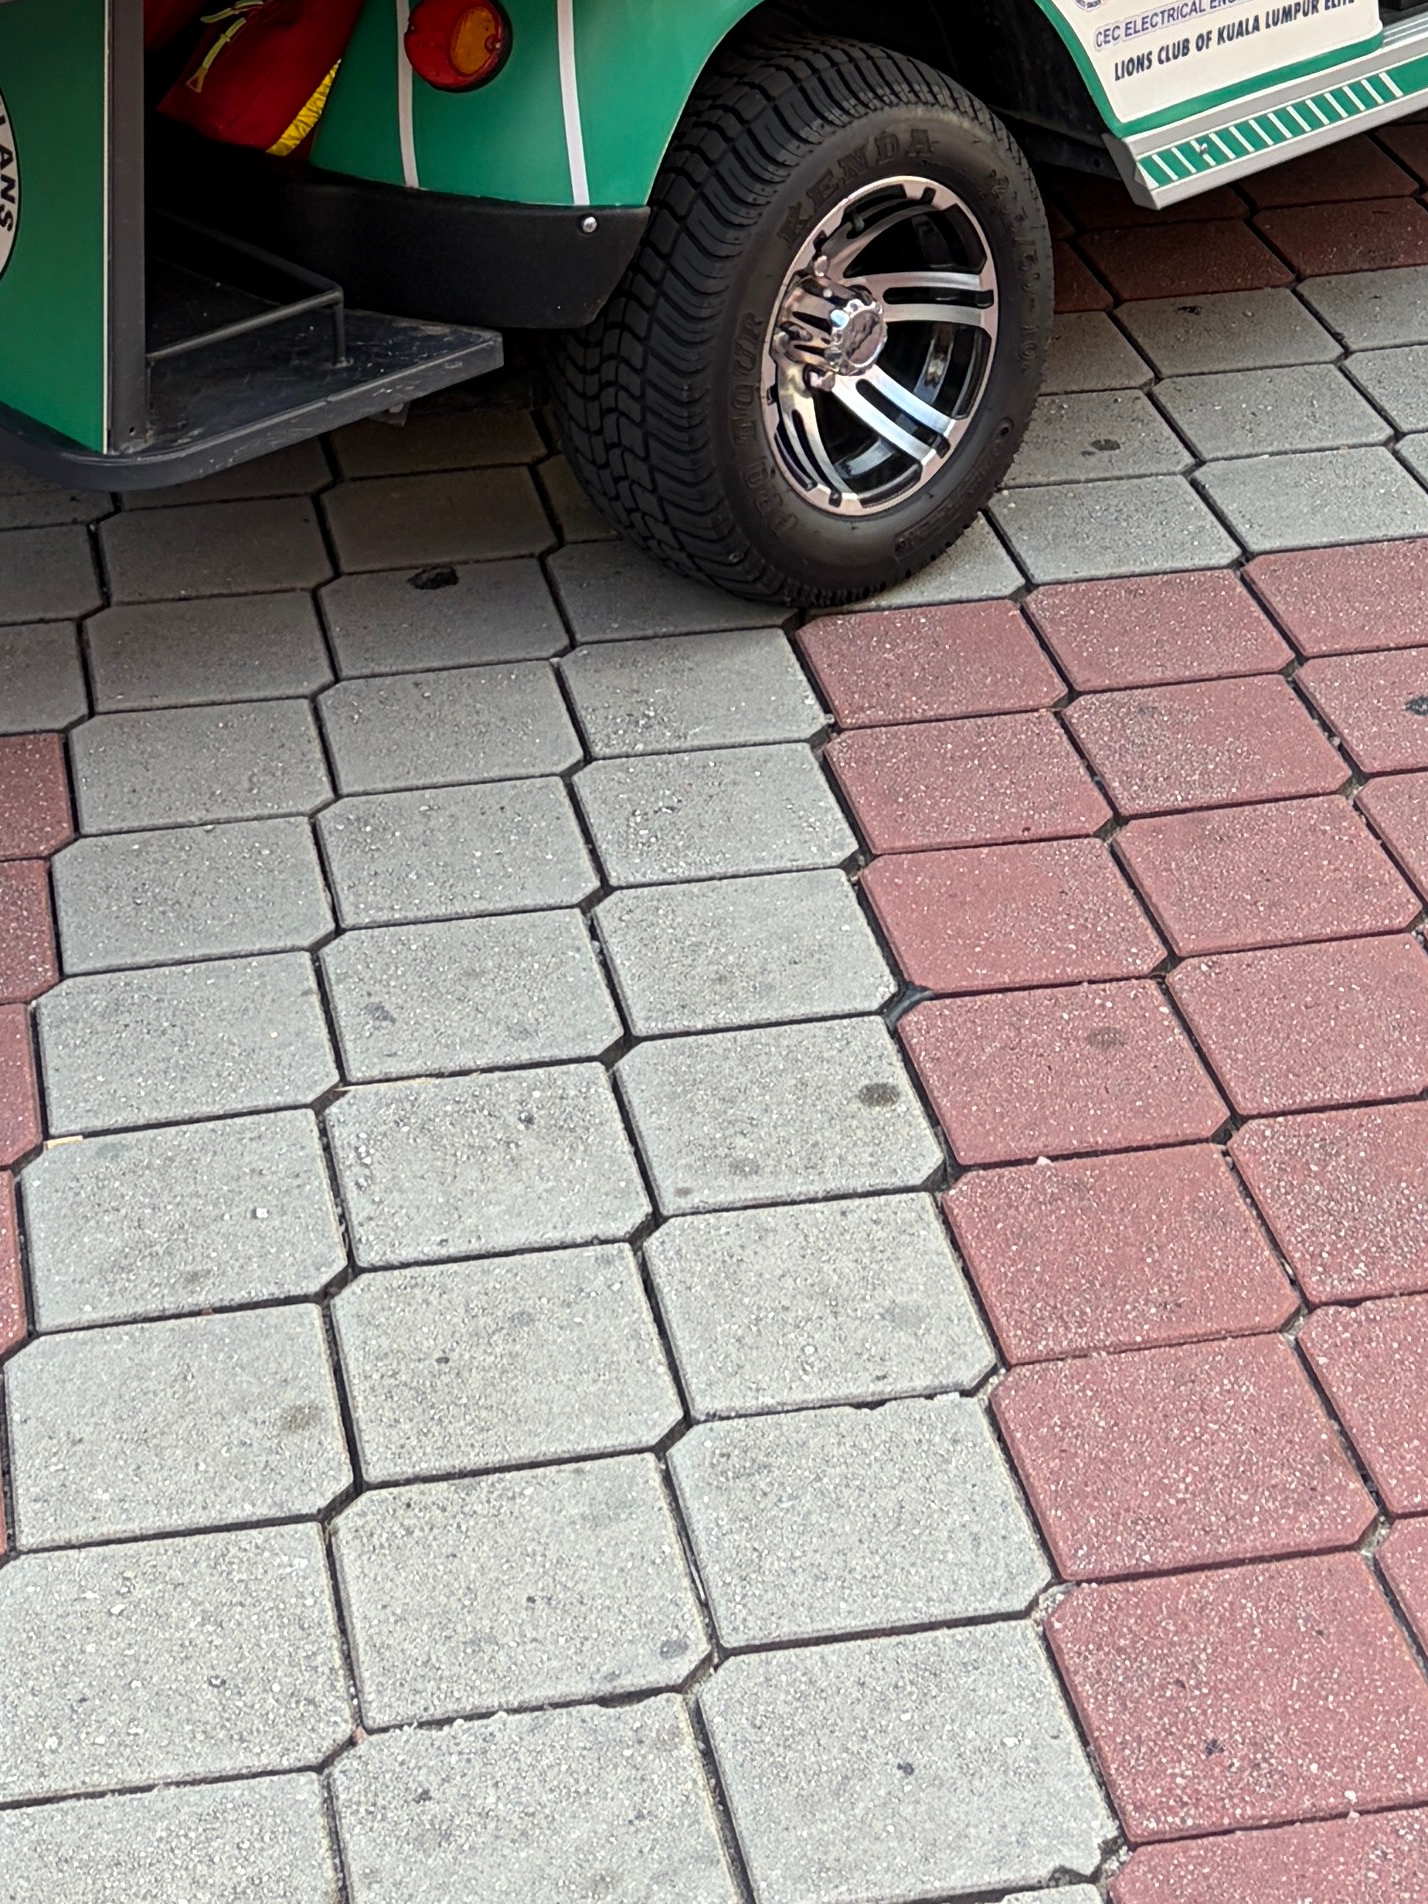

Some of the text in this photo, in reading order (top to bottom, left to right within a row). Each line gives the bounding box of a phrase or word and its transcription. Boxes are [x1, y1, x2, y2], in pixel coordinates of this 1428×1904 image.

[1096, 24, 1121, 49] CEC
[1124, 2, 1207, 39] ELECTRICAL
[1114, 49, 1153, 82] LIONS
[1157, 38, 1191, 66] CLUB
[1195, 29, 1214, 52] OF
[1217, 14, 1261, 45] KUALA
[776, 127, 934, 250] KENDA
[730, 311, 766, 446] TOUR
